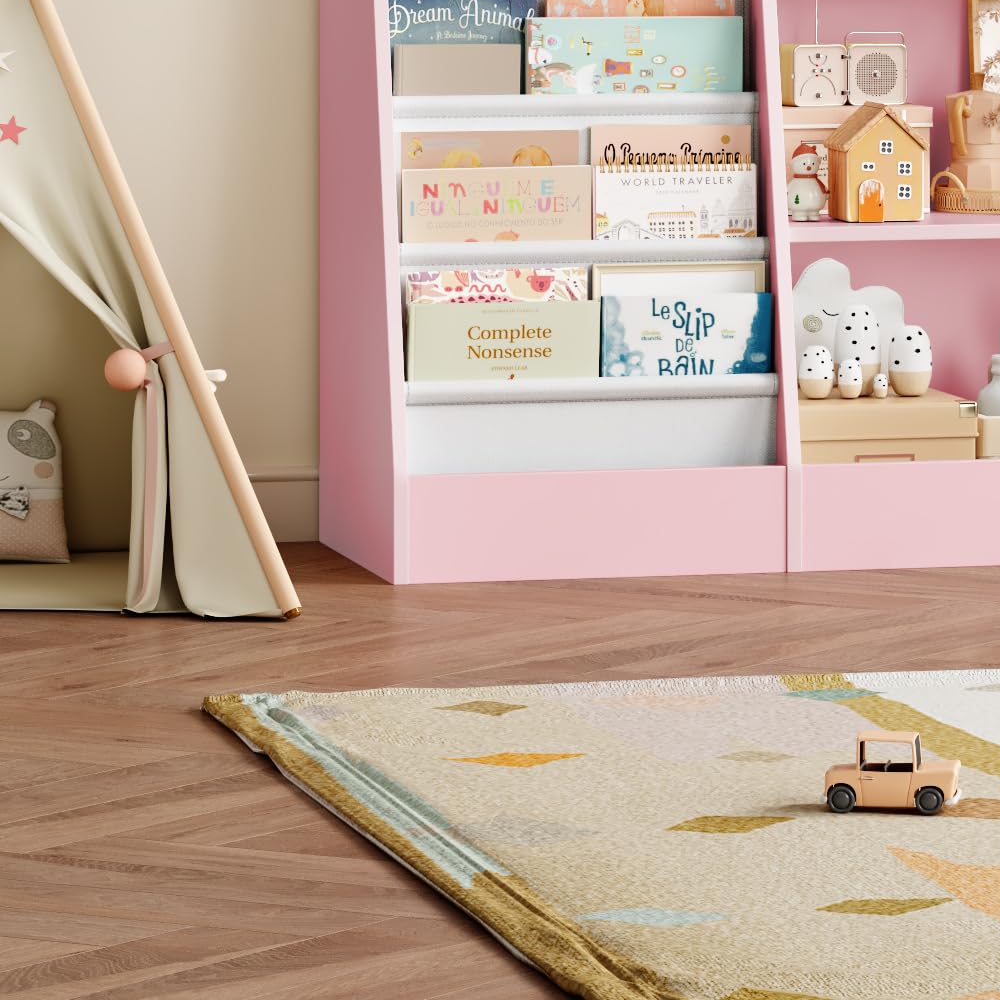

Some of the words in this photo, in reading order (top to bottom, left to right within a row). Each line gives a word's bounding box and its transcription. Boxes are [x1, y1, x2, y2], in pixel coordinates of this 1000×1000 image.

[388, 0, 455, 39] Dream
[604, 143, 616, 165] O
[620, 176, 666, 187] WORLD
[672, 175, 734, 186] TRAVELER
[651, 298, 671, 320] Le
[467, 324, 553, 344] Complete
[467, 345, 553, 360] Nonsense
